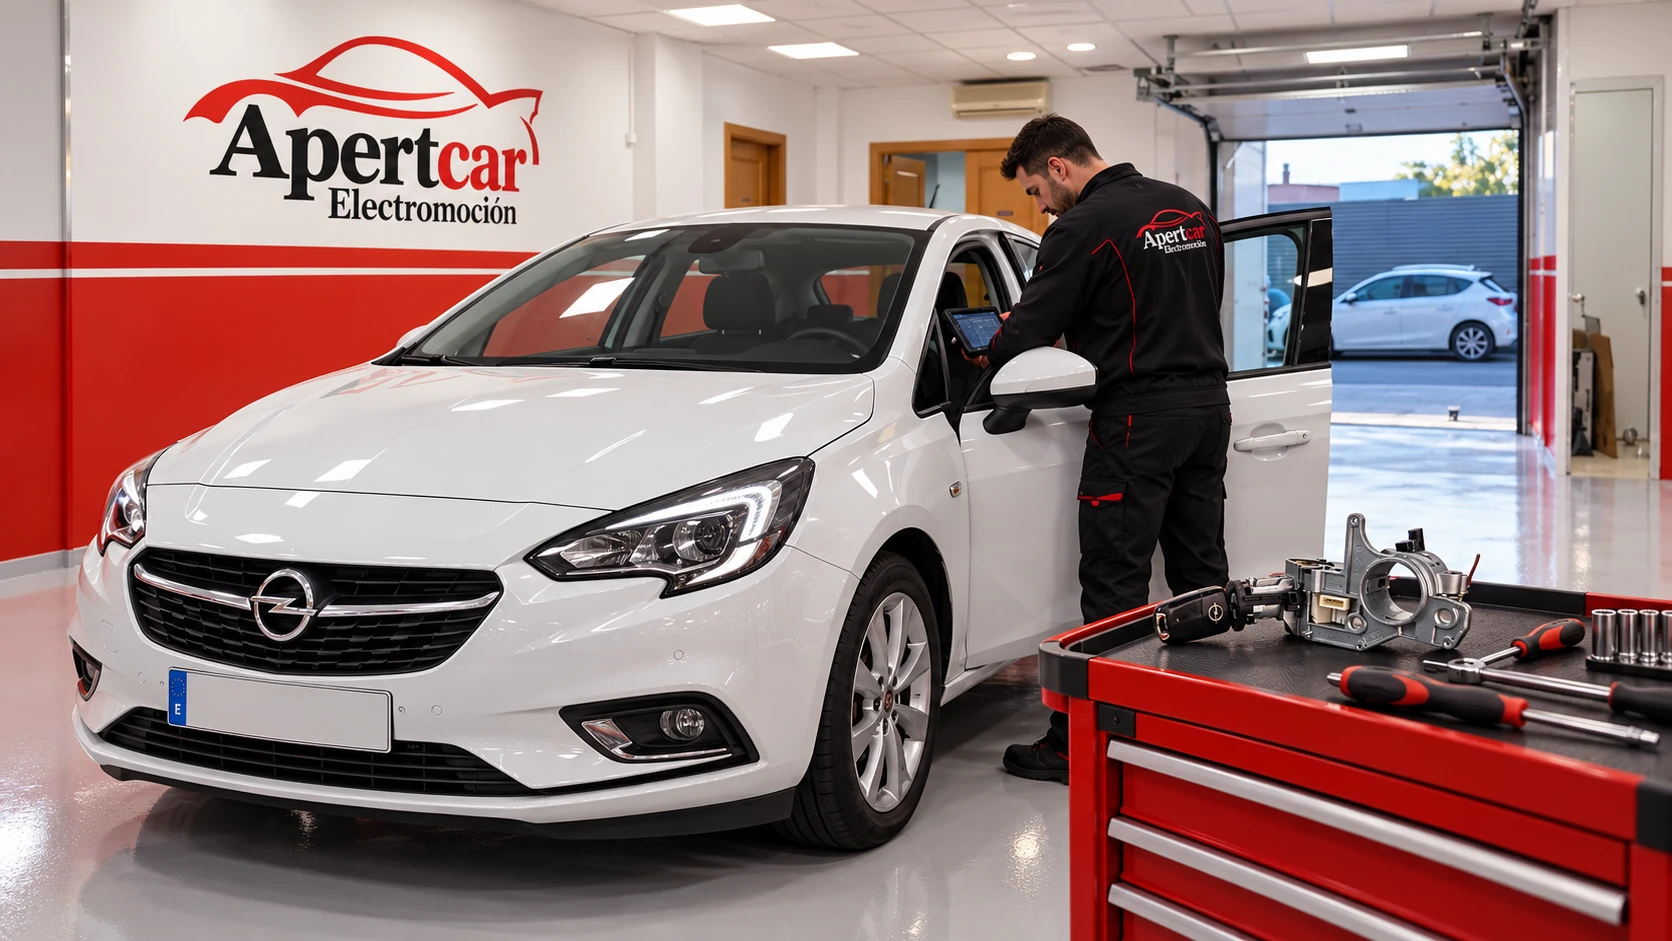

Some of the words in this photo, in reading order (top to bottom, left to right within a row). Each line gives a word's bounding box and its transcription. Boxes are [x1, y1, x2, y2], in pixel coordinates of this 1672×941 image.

[209, 103, 527, 201] Apertcar
[327, 186, 518, 225] Electromoción
[1143, 225, 1206, 250] Apertcar
[174, 703, 181, 716] E
